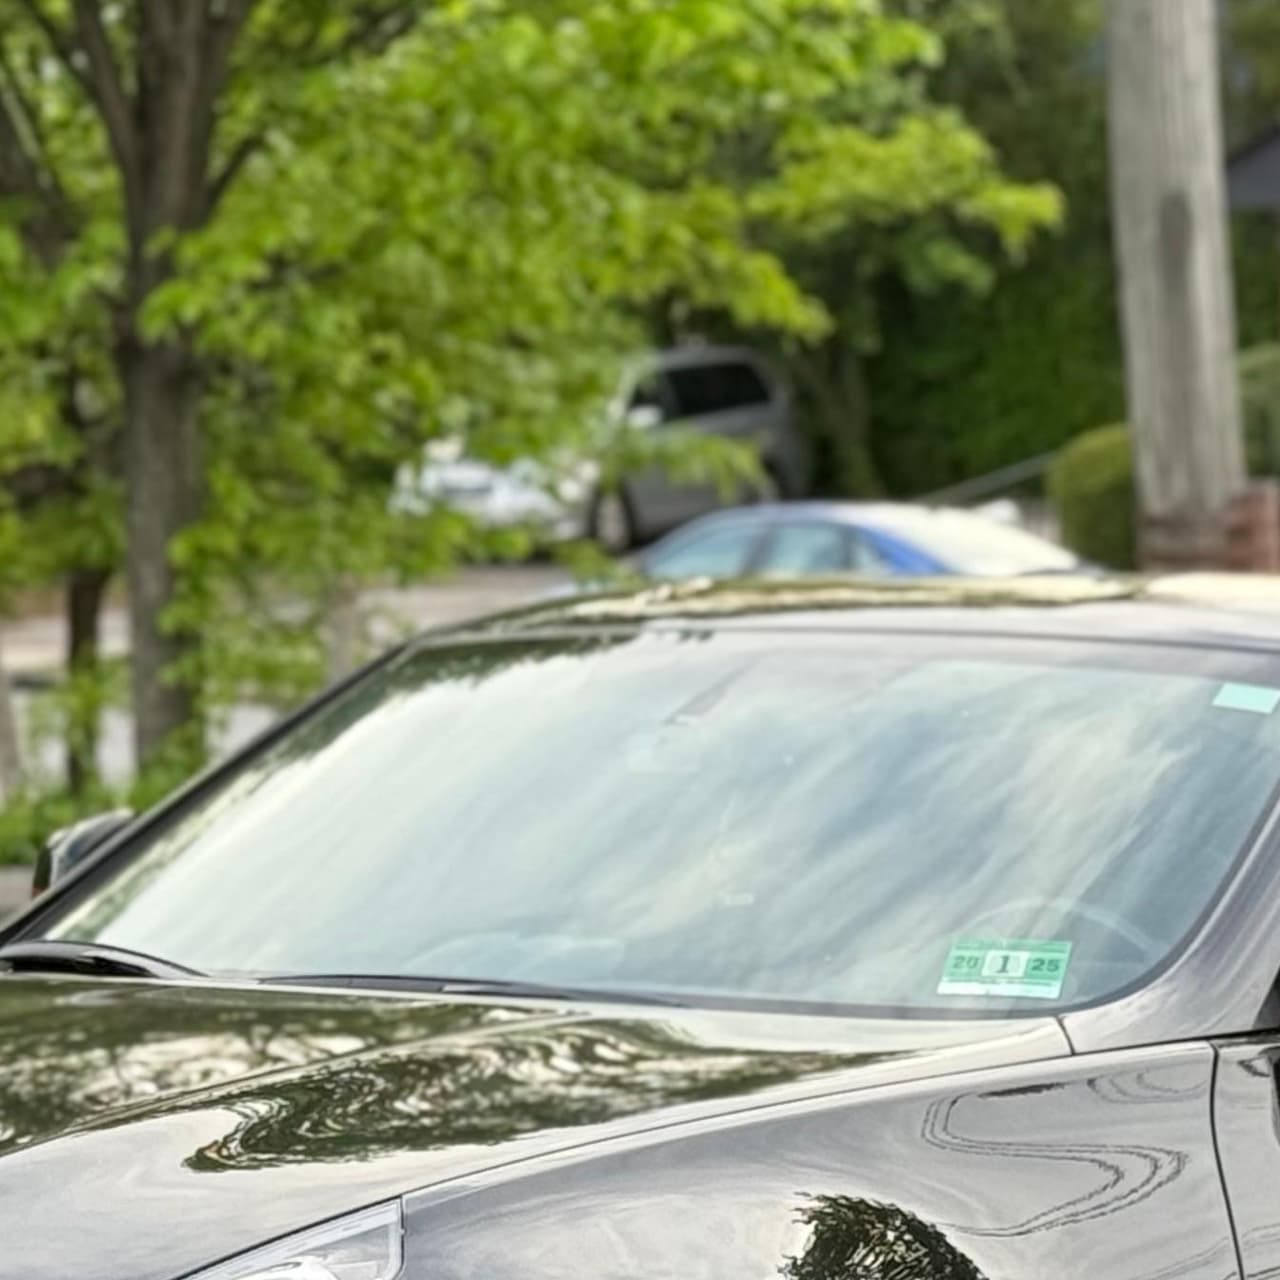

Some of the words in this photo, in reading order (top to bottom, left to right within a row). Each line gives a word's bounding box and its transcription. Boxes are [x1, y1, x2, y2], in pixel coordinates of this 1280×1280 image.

[953, 955, 979, 969] 20
[996, 955, 1011, 974] 1
[1031, 958, 1059, 972] 25
